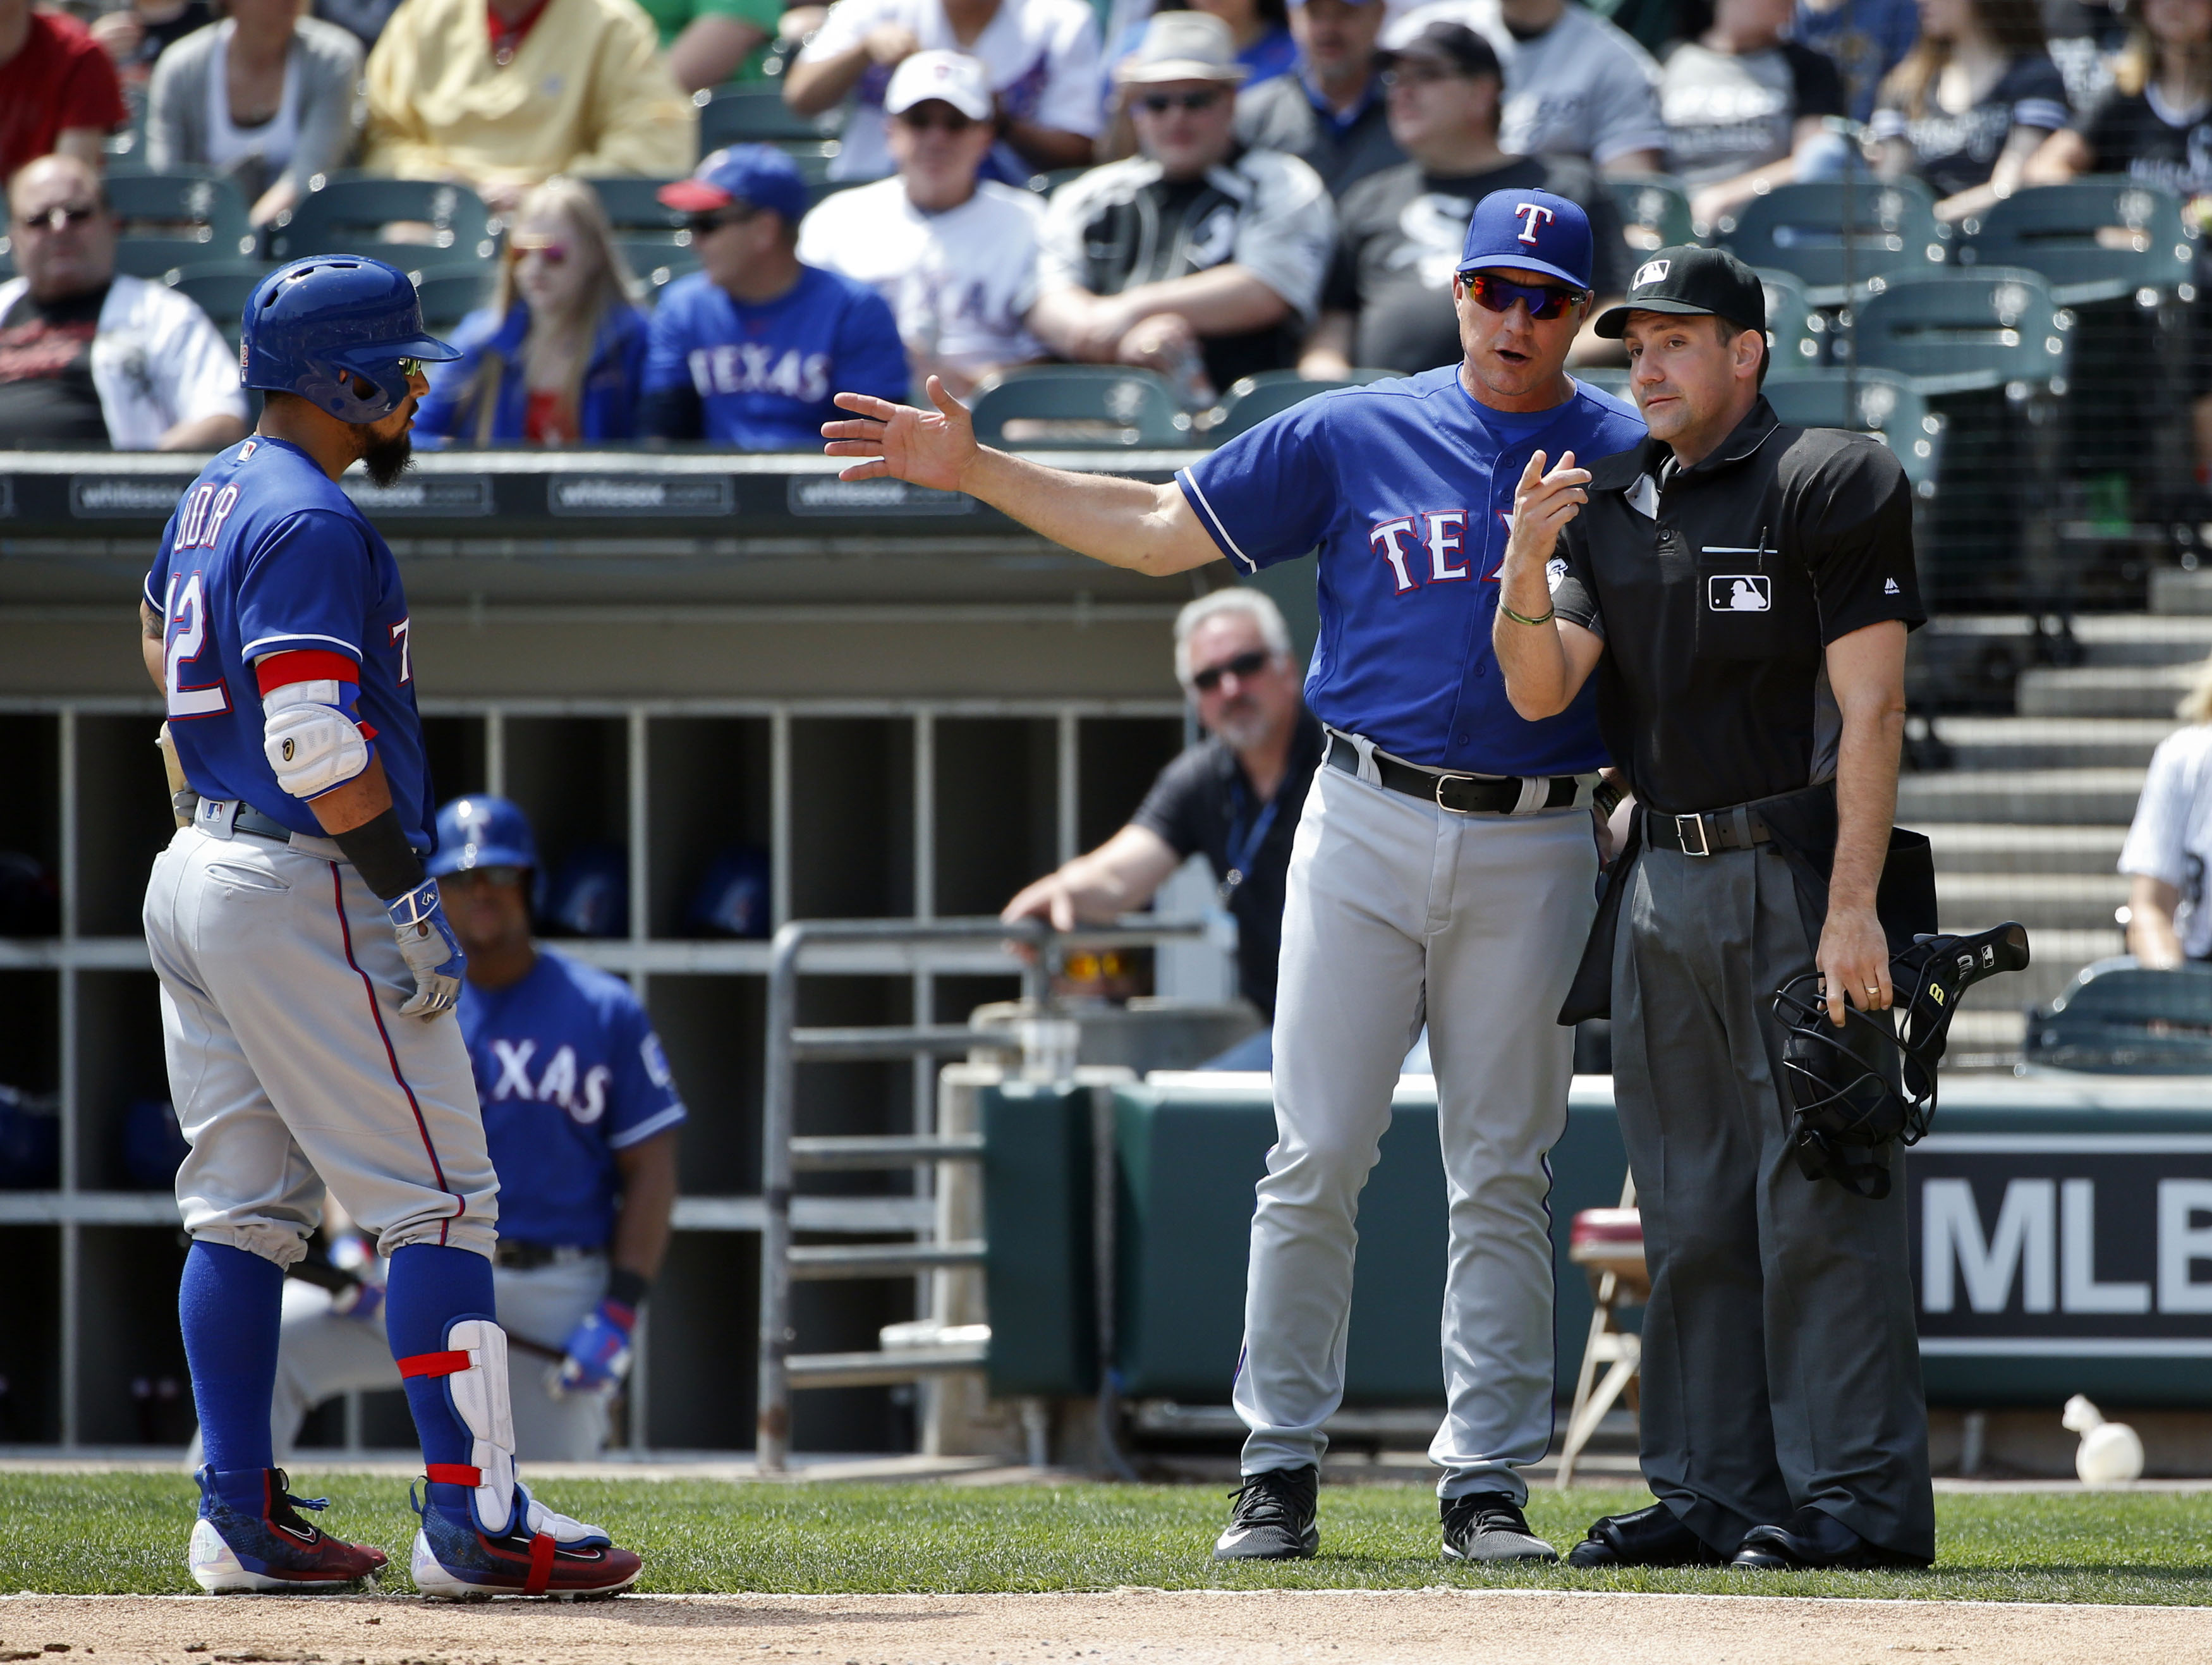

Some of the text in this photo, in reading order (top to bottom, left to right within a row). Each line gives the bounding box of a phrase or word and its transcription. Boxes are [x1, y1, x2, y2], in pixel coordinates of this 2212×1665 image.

[1515, 203, 1556, 247] T
[687, 342, 832, 403] TEXAS
[474, 1038, 611, 1125] XAS
